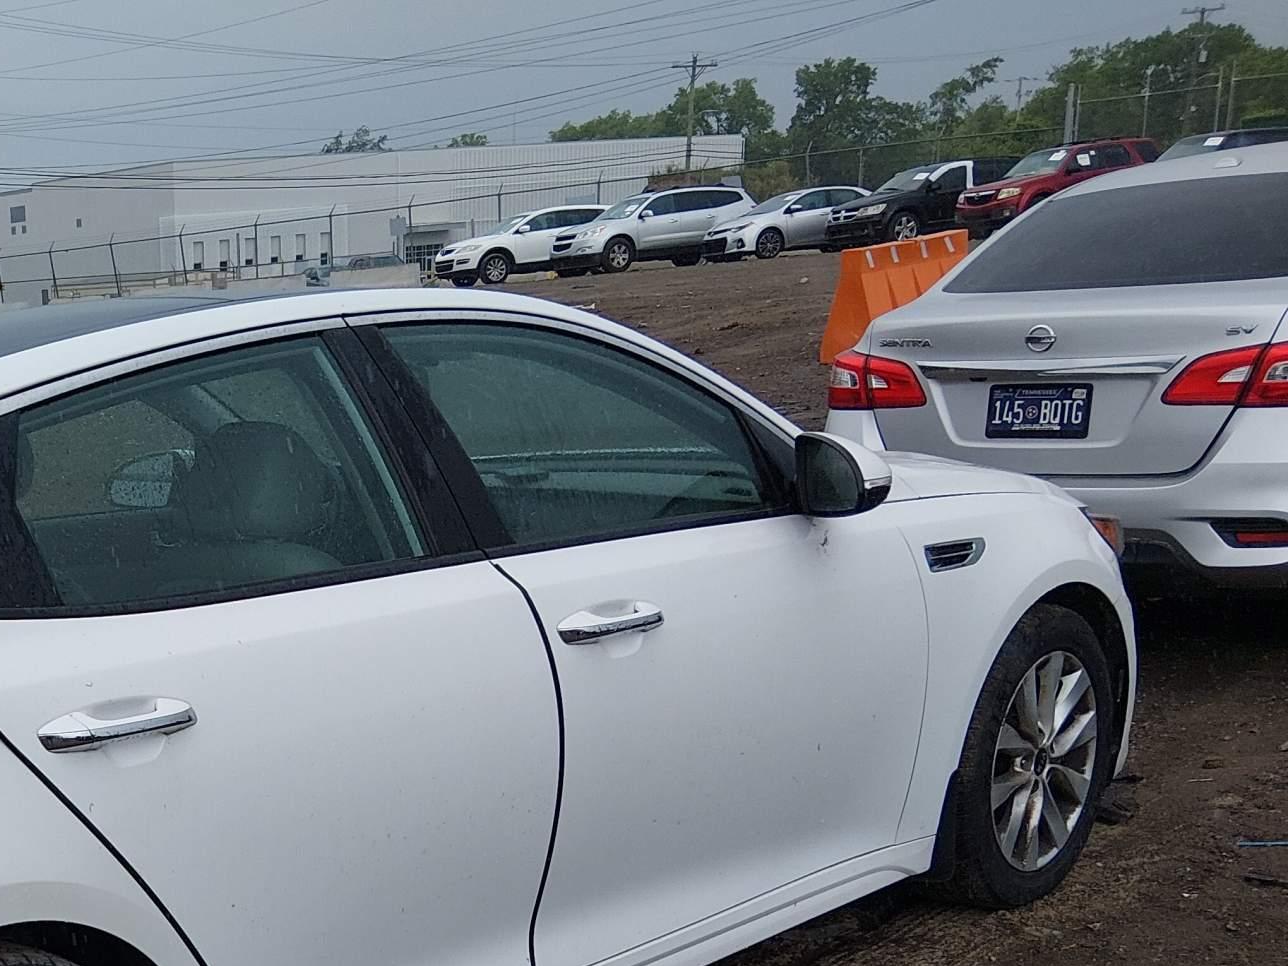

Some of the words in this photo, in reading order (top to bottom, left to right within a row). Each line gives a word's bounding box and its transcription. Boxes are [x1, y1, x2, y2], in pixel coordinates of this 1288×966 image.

[1225, 324, 1259, 336] SV
[879, 338, 934, 348] SENTRA
[991, 400, 1025, 424] 145
[1039, 399, 1084, 424] BQTG
